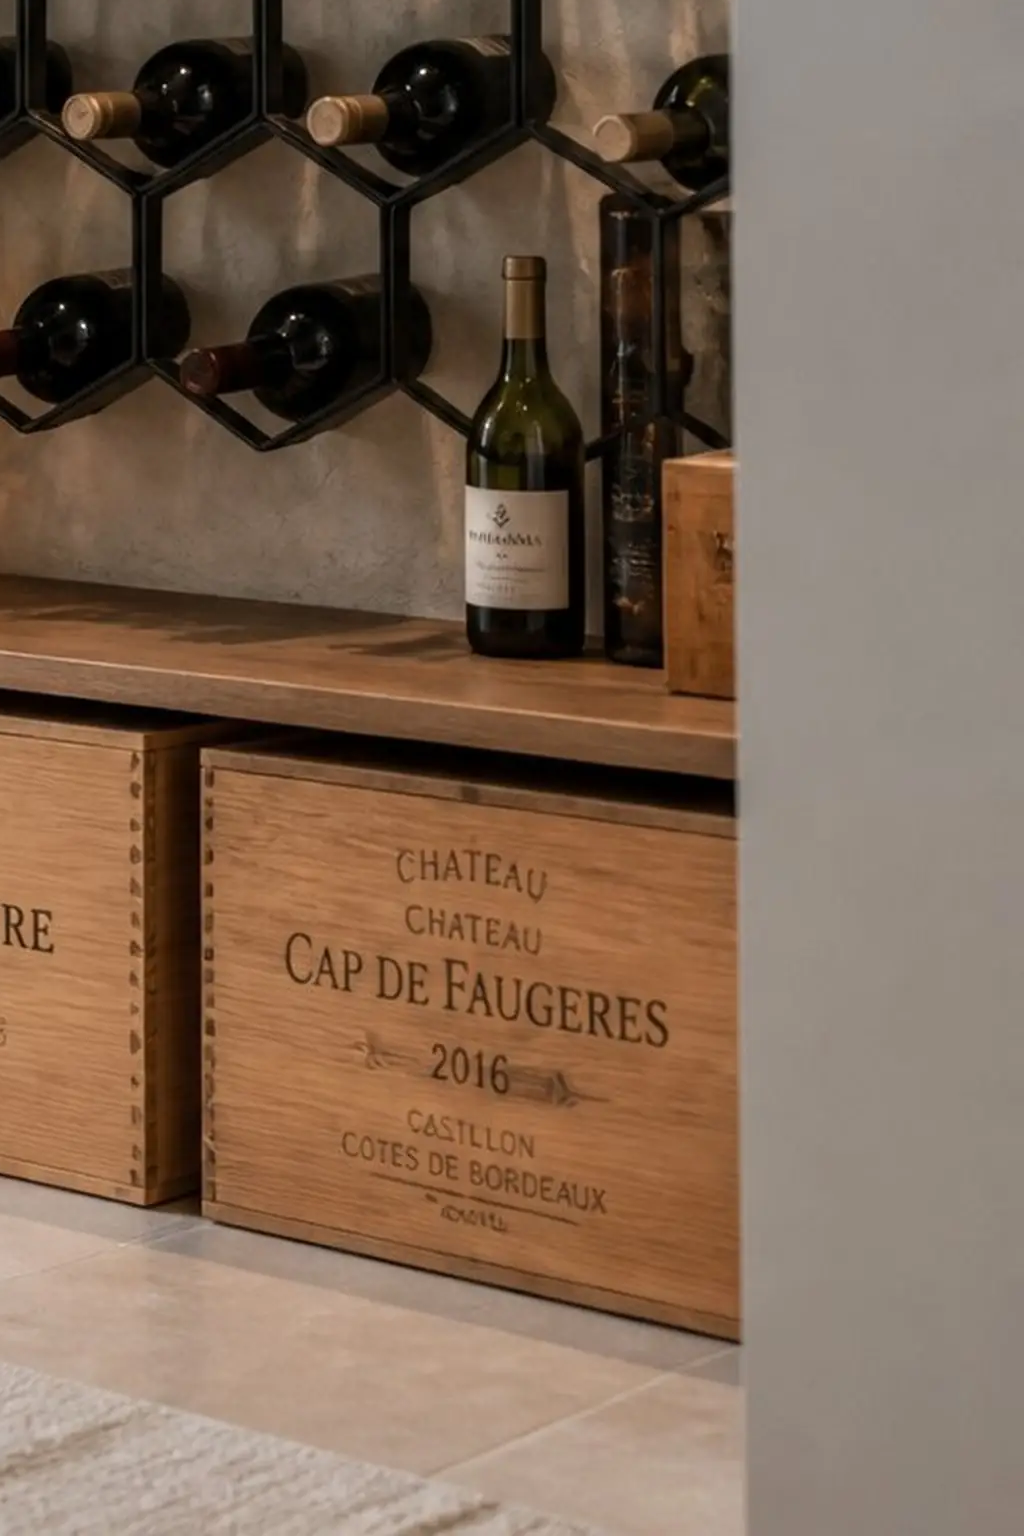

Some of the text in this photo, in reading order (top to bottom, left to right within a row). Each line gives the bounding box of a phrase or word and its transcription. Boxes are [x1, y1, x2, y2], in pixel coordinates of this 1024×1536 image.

[396, 848, 547, 904] CHATEAU
[405, 904, 543, 956] CHATEAU
[284, 932, 670, 1049] CAP DE FAUGERES
[431, 1042, 510, 1095] 2016
[342, 1131, 608, 1214] COTES DE BORDEAUX
